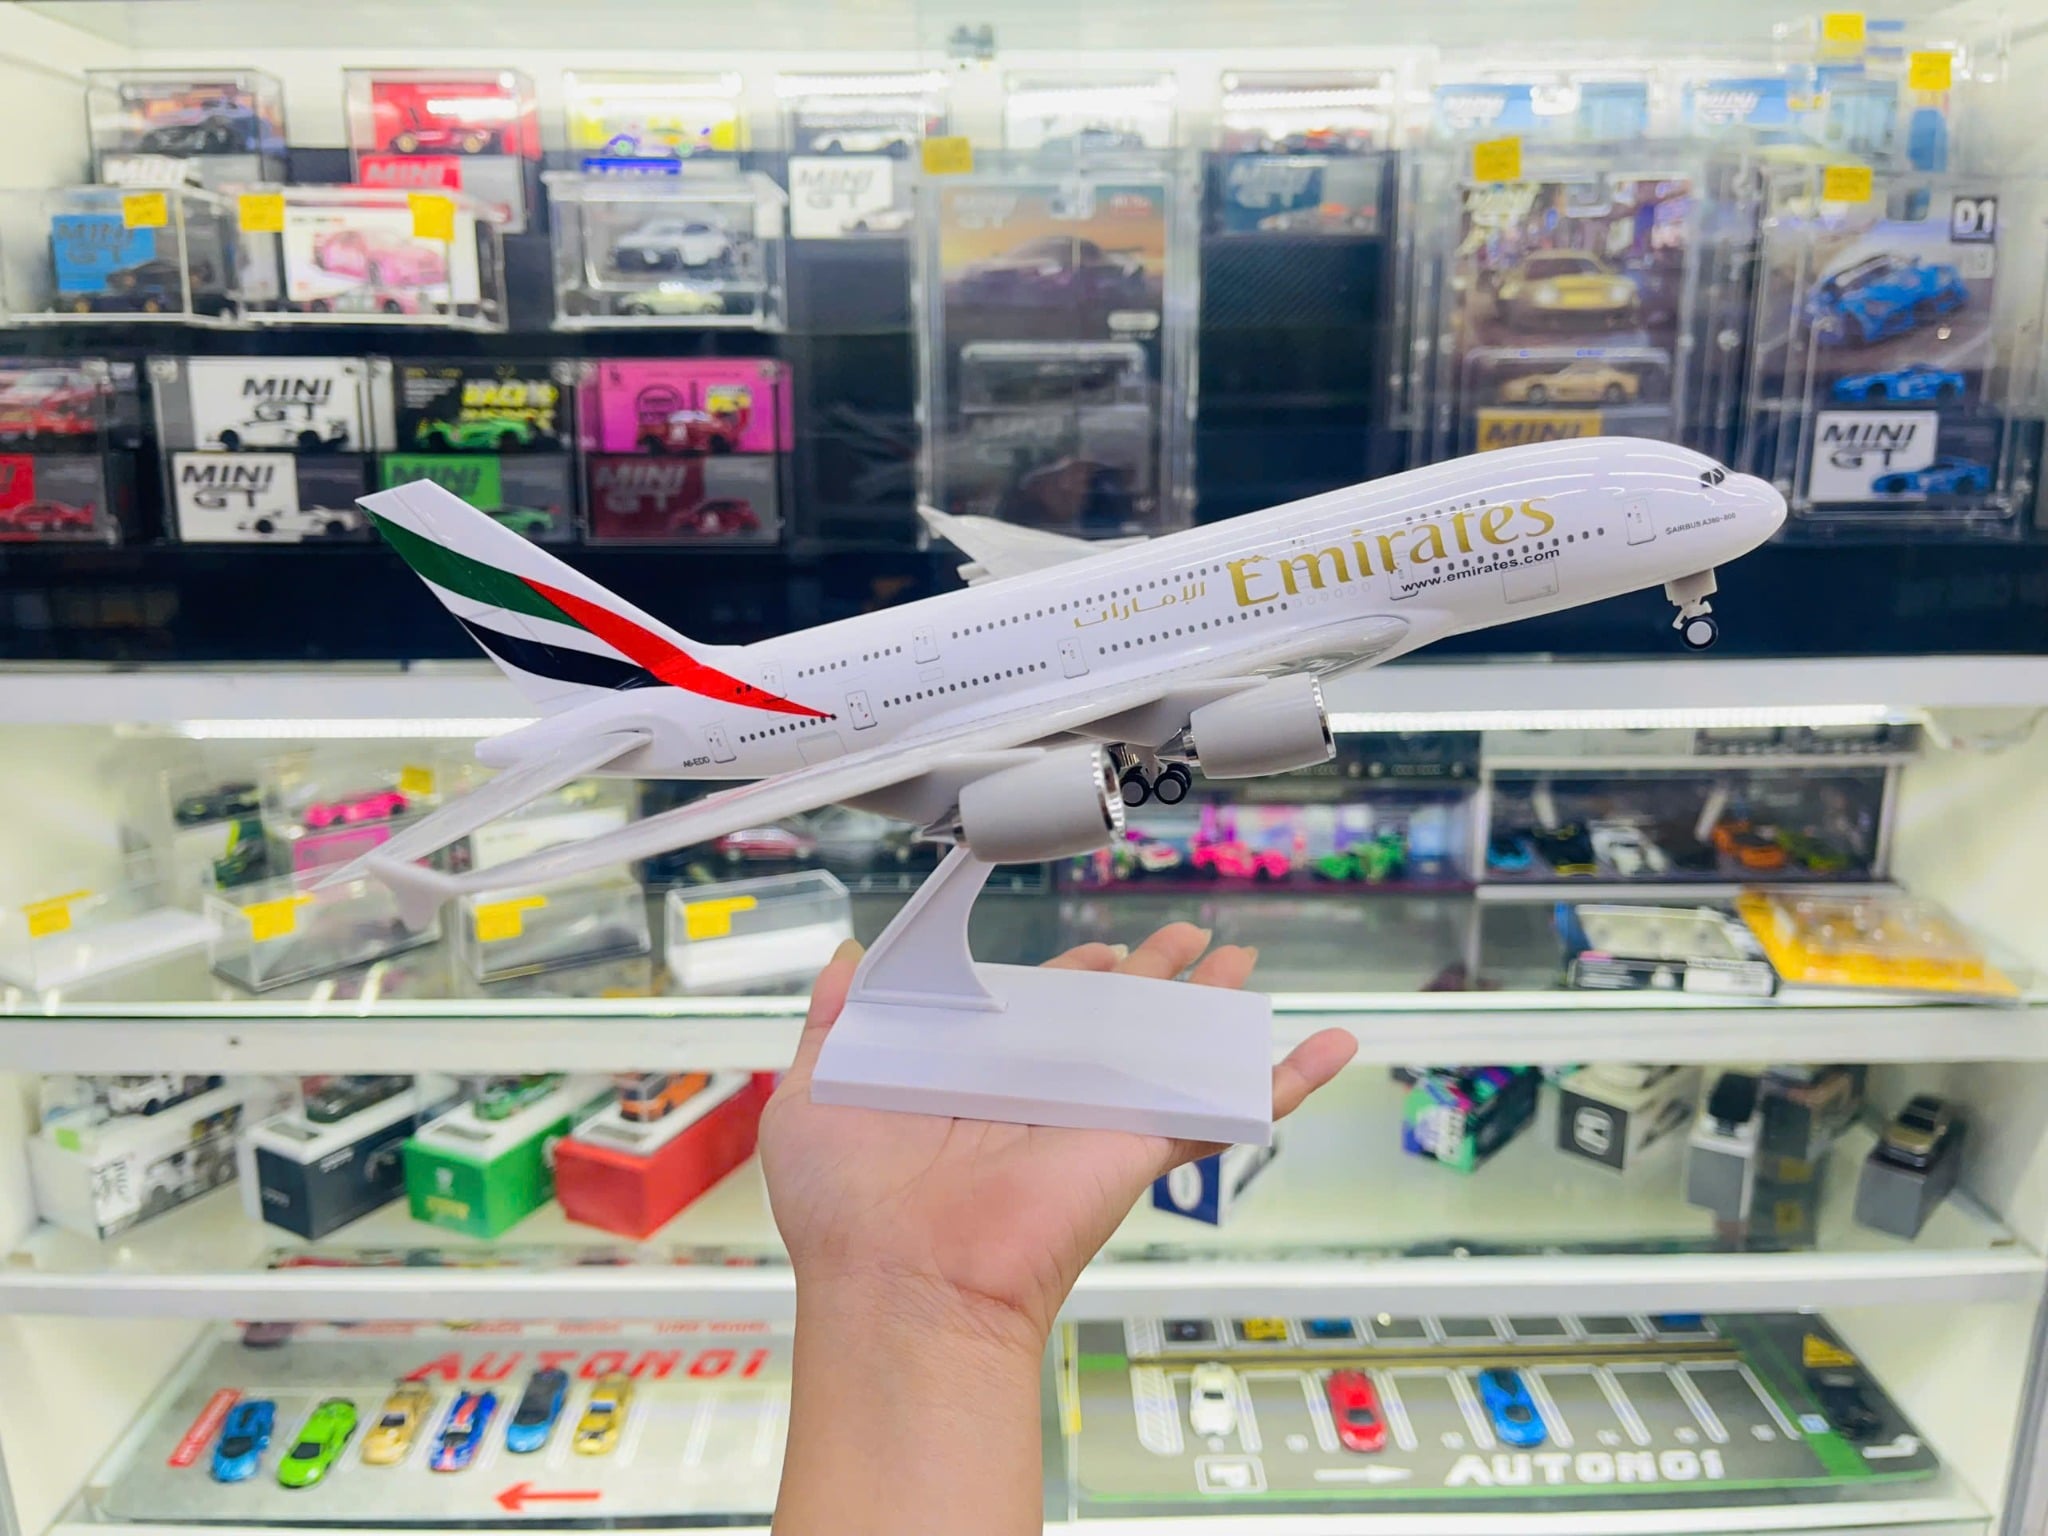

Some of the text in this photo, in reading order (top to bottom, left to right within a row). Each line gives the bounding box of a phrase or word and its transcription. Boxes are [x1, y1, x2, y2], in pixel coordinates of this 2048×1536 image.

[243, 378, 332, 396] MINI
[254, 401, 314, 422] GT
[1487, 423, 1581, 443] MINI
[1823, 424, 1917, 442] MINI
[1830, 448, 1893, 469] GT
[182, 465, 275, 484] MINI
[596, 464, 686, 486] MINI
[193, 488, 256, 508] GT
[1226, 498, 1556, 607] Emirates
[1400, 548, 1561, 592] www.emirates.com
[1074, 581, 1206, 628] الإمارات
